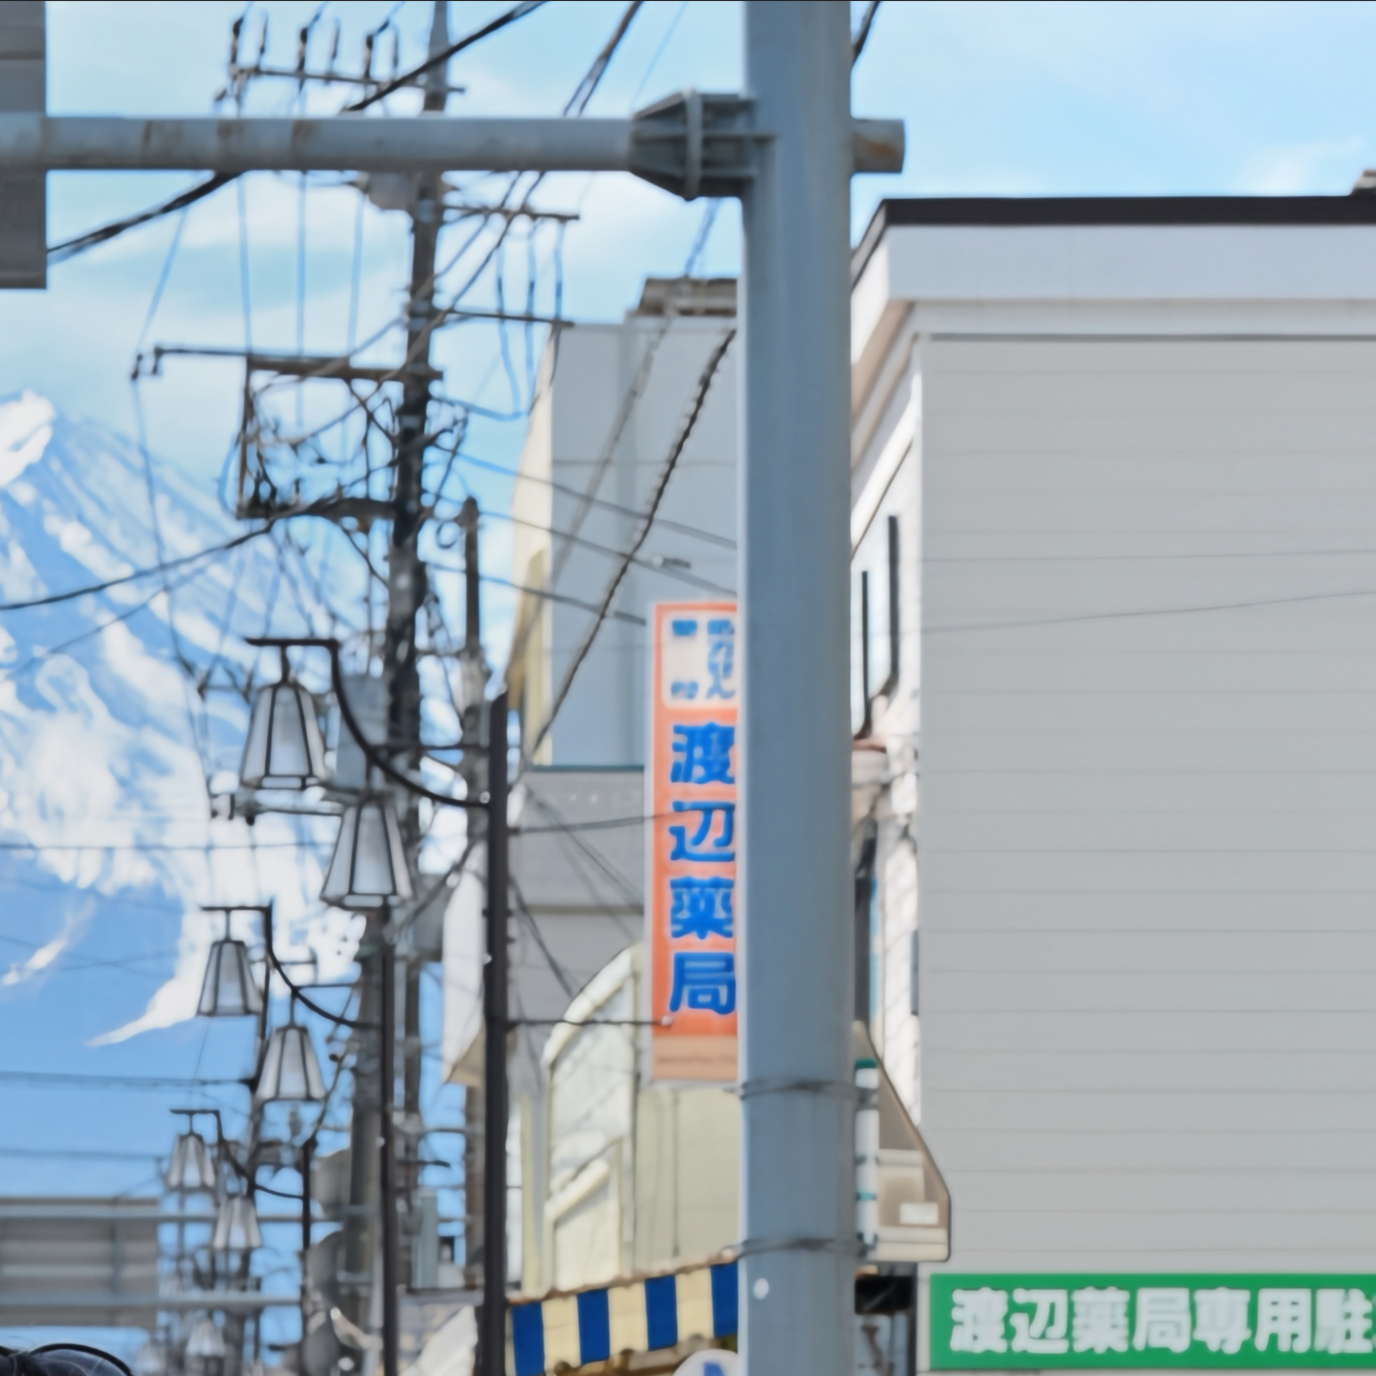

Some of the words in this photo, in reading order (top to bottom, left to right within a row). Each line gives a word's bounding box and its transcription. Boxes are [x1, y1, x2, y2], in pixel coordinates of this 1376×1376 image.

[669, 721, 736, 1015] 渡辺薬局
[950, 1286, 1376, 1355] 渡辺薬局専用駐
